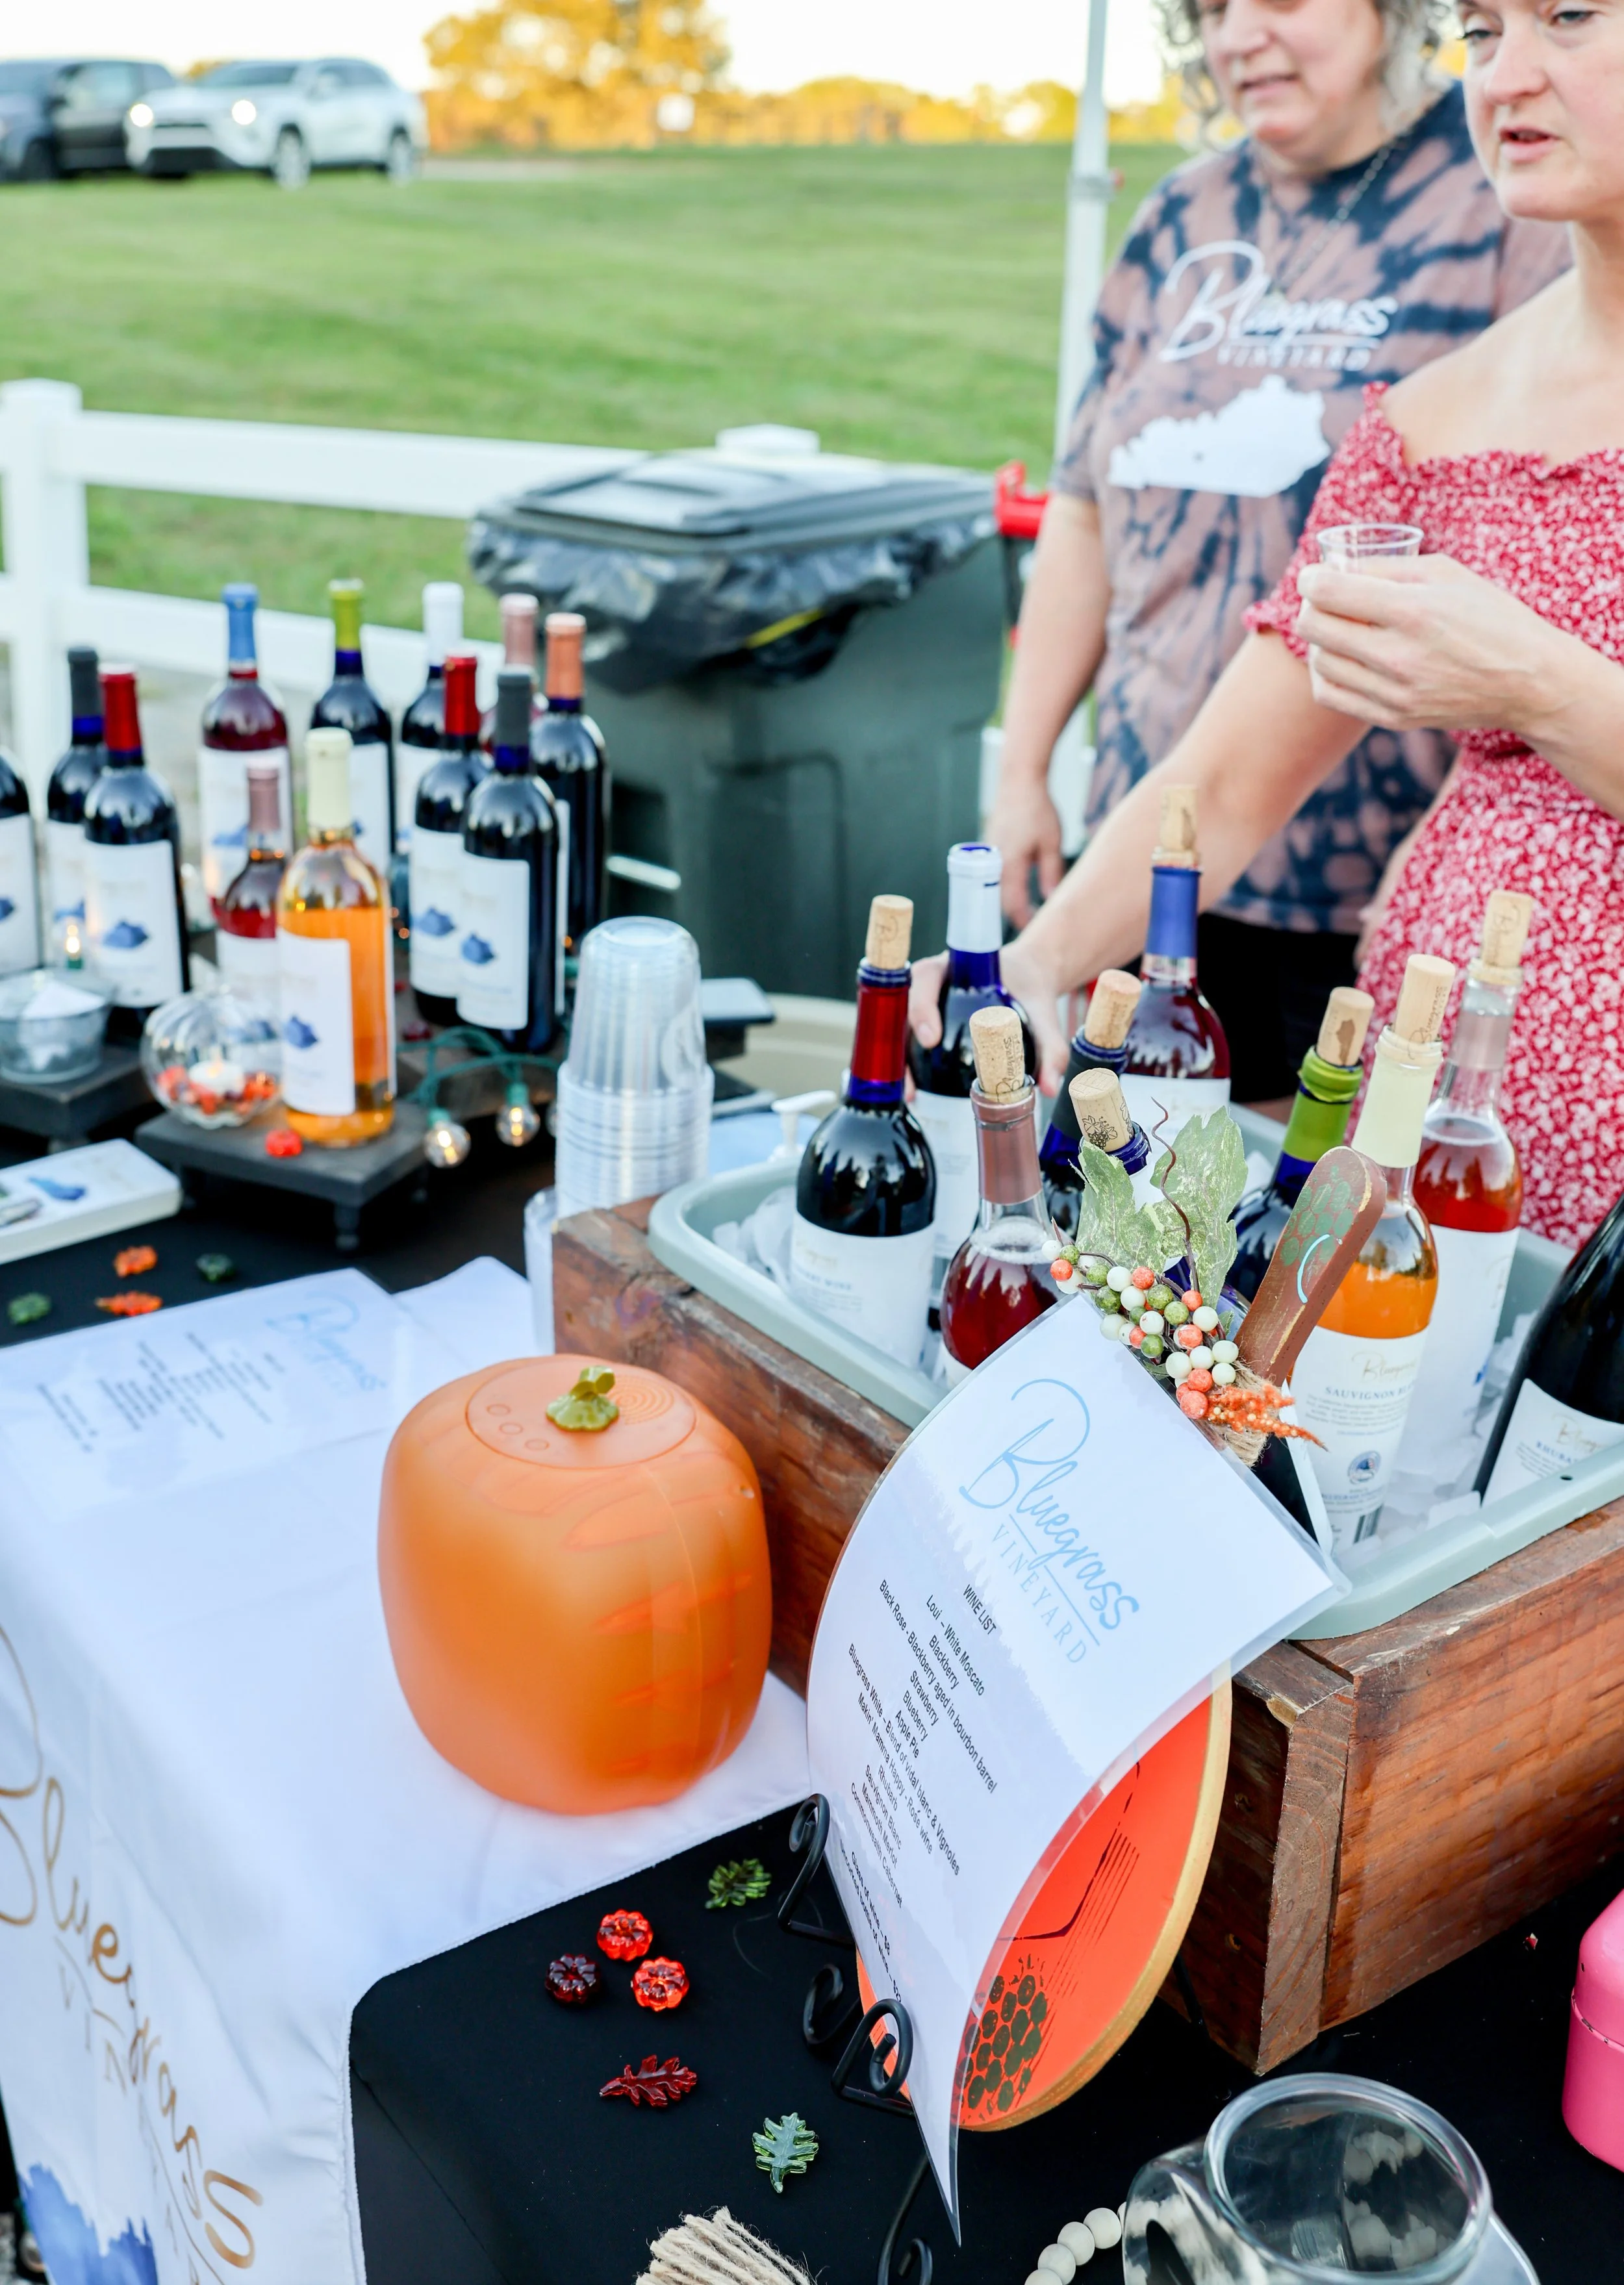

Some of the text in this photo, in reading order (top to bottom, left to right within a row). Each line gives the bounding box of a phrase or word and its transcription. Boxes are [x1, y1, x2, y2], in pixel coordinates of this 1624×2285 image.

[1159, 240, 1398, 366] Bluegrass
[996, 1037, 1020, 1103] Bluegrass
[1325, 1386, 1395, 1400] SAUVIGNON
[959, 1378, 1139, 1630] Bluegrass
[962, 1583, 996, 1635] WINE LIST
[993, 1524, 1086, 1663] VINEYARD
[879, 1578, 894, 1610] Black
[891, 1602, 907, 1631] Rose
[907, 1630, 937, 1685] Blackberry
[933, 1681, 951, 1709] aged
[946, 1702, 955, 1720] in
[952, 1713, 978, 1762] bourbon
[975, 1756, 997, 1793] barrel
[926, 1594, 943, 1621] Loui
[943, 1623, 961, 1656] White
[958, 1650, 985, 1696] Moscato
[928, 1634, 959, 1690] Blackberry
[894, 1709, 919, 1758] Apple Pie
[902, 1689, 928, 1742] Blueberry
[909, 1669, 939, 1726] Strawberry
[848, 1642, 870, 1691] Bluegrass
[869, 1684, 883, 1717] White
[885, 1719, 902, 1754] Blend
[898, 1751, 907, 1765] of
[904, 1761, 919, 1790] vidal
[916, 1784, 932, 1819] blanc
[930, 1814, 937, 1830] &
[935, 1823, 959, 1876] Vignoles
[857, 1691, 874, 1725] Makin'
[871, 1721, 890, 1764] Mamma
[888, 1758, 905, 1797] Happy
[919, 1826, 932, 1854] wine
[877, 1763, 898, 1812] Rhubarb
[850, 1782, 902, 1909] Commonwealth Cabernet
[861, 1781, 897, 1869] Mammoth Merlot
[865, 1763, 902, 1850] Sauvignon Blanc
[852, 1852, 863, 1887] Glass
[869, 1898, 880, 1930] wine
[859, 1891, 872, 1930] bottle
[878, 1942, 889, 1973] wine
